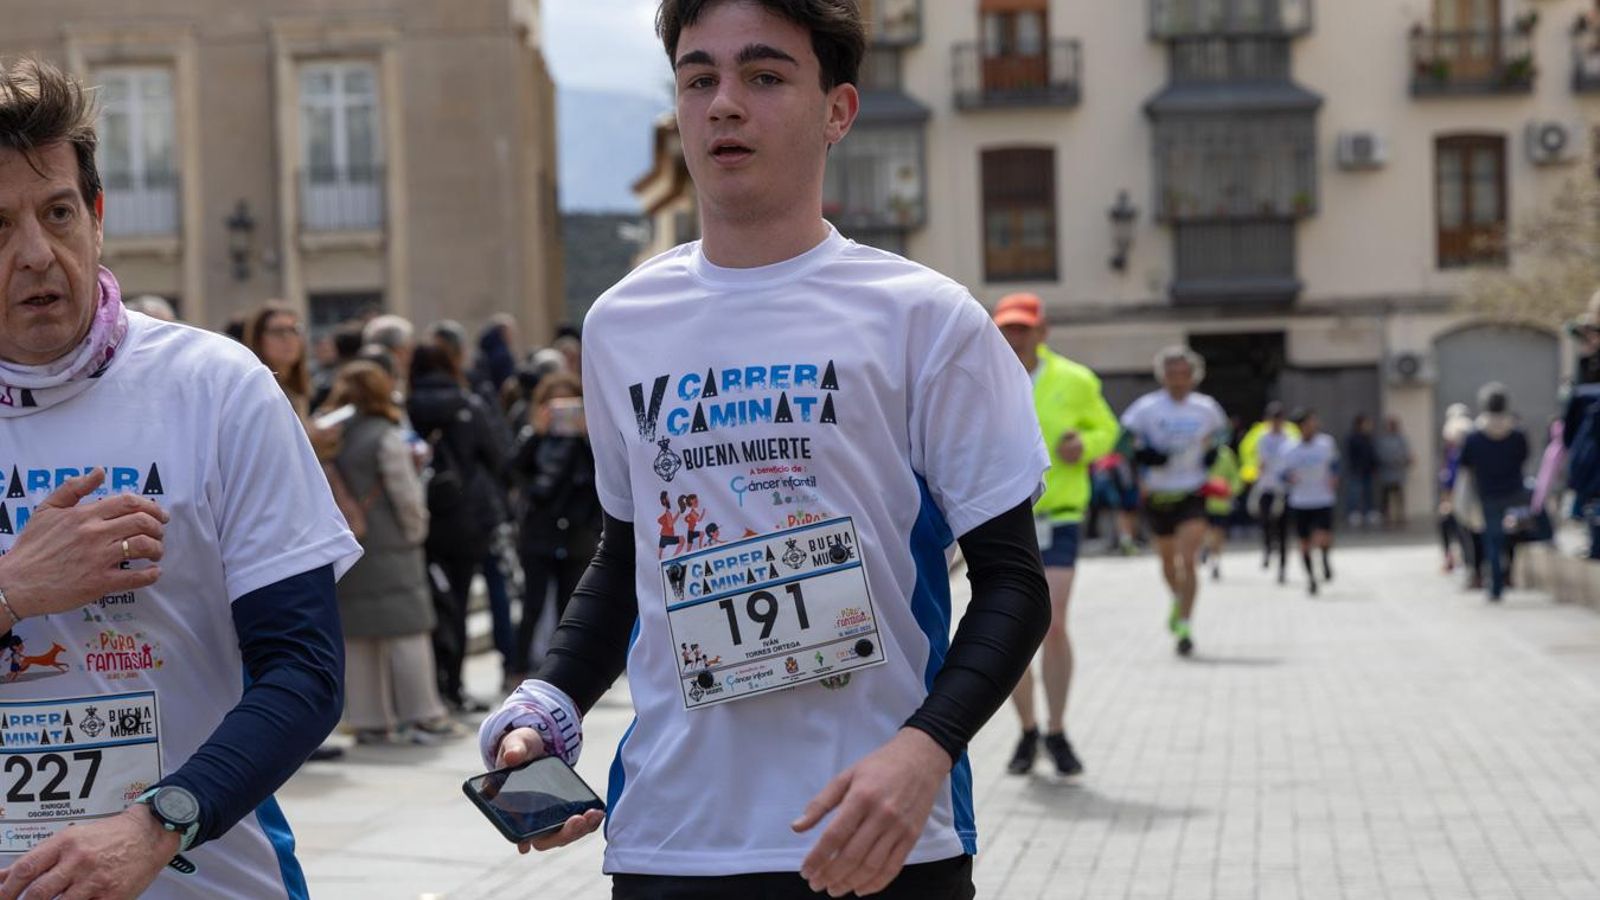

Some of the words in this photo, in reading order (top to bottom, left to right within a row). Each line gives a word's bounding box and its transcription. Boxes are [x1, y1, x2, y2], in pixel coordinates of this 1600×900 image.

[677, 359, 839, 400] CARRERA
[629, 374, 670, 443] V
[666, 391, 837, 436] CAMINATA
[683, 442, 739, 471] BUENA
[742, 437, 811, 467] MUERTE
[781, 475, 816, 491] infantil
[808, 531, 852, 552] BUENA
[692, 545, 776, 578] CARRERA
[689, 562, 779, 597] CAMINATA
[719, 582, 810, 646] 191
[745, 647, 772, 659] TORRES
[772, 640, 801, 653] ORTEGA
[4, 750, 102, 803] 227
